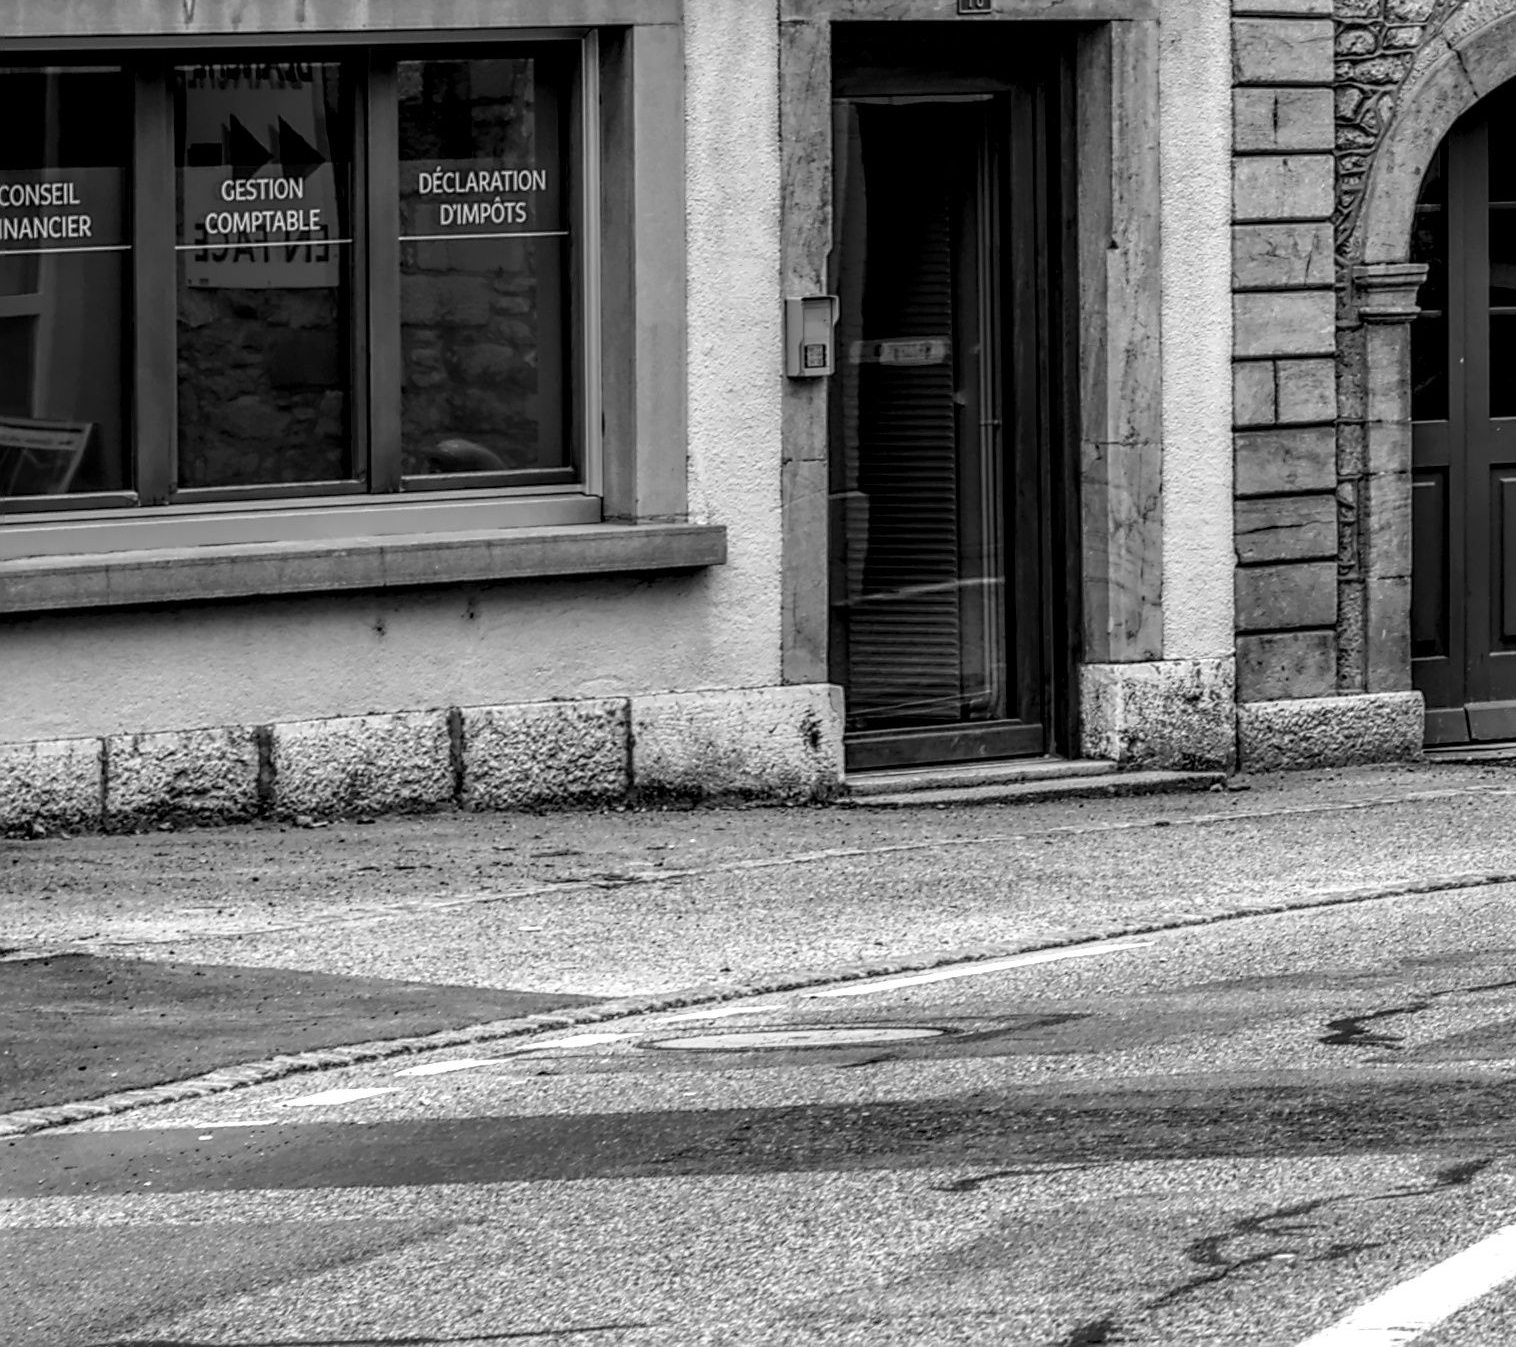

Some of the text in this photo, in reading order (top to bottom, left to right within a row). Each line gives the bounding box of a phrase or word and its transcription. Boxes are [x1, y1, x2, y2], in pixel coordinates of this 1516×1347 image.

[221, 177, 304, 201] GESTION
[418, 165, 547, 194] DÉCLARATION
[0, 182, 81, 206] CONSEIL
[205, 209, 321, 235] COMPTABLE
[439, 195, 527, 226] D'IMPÔTS
